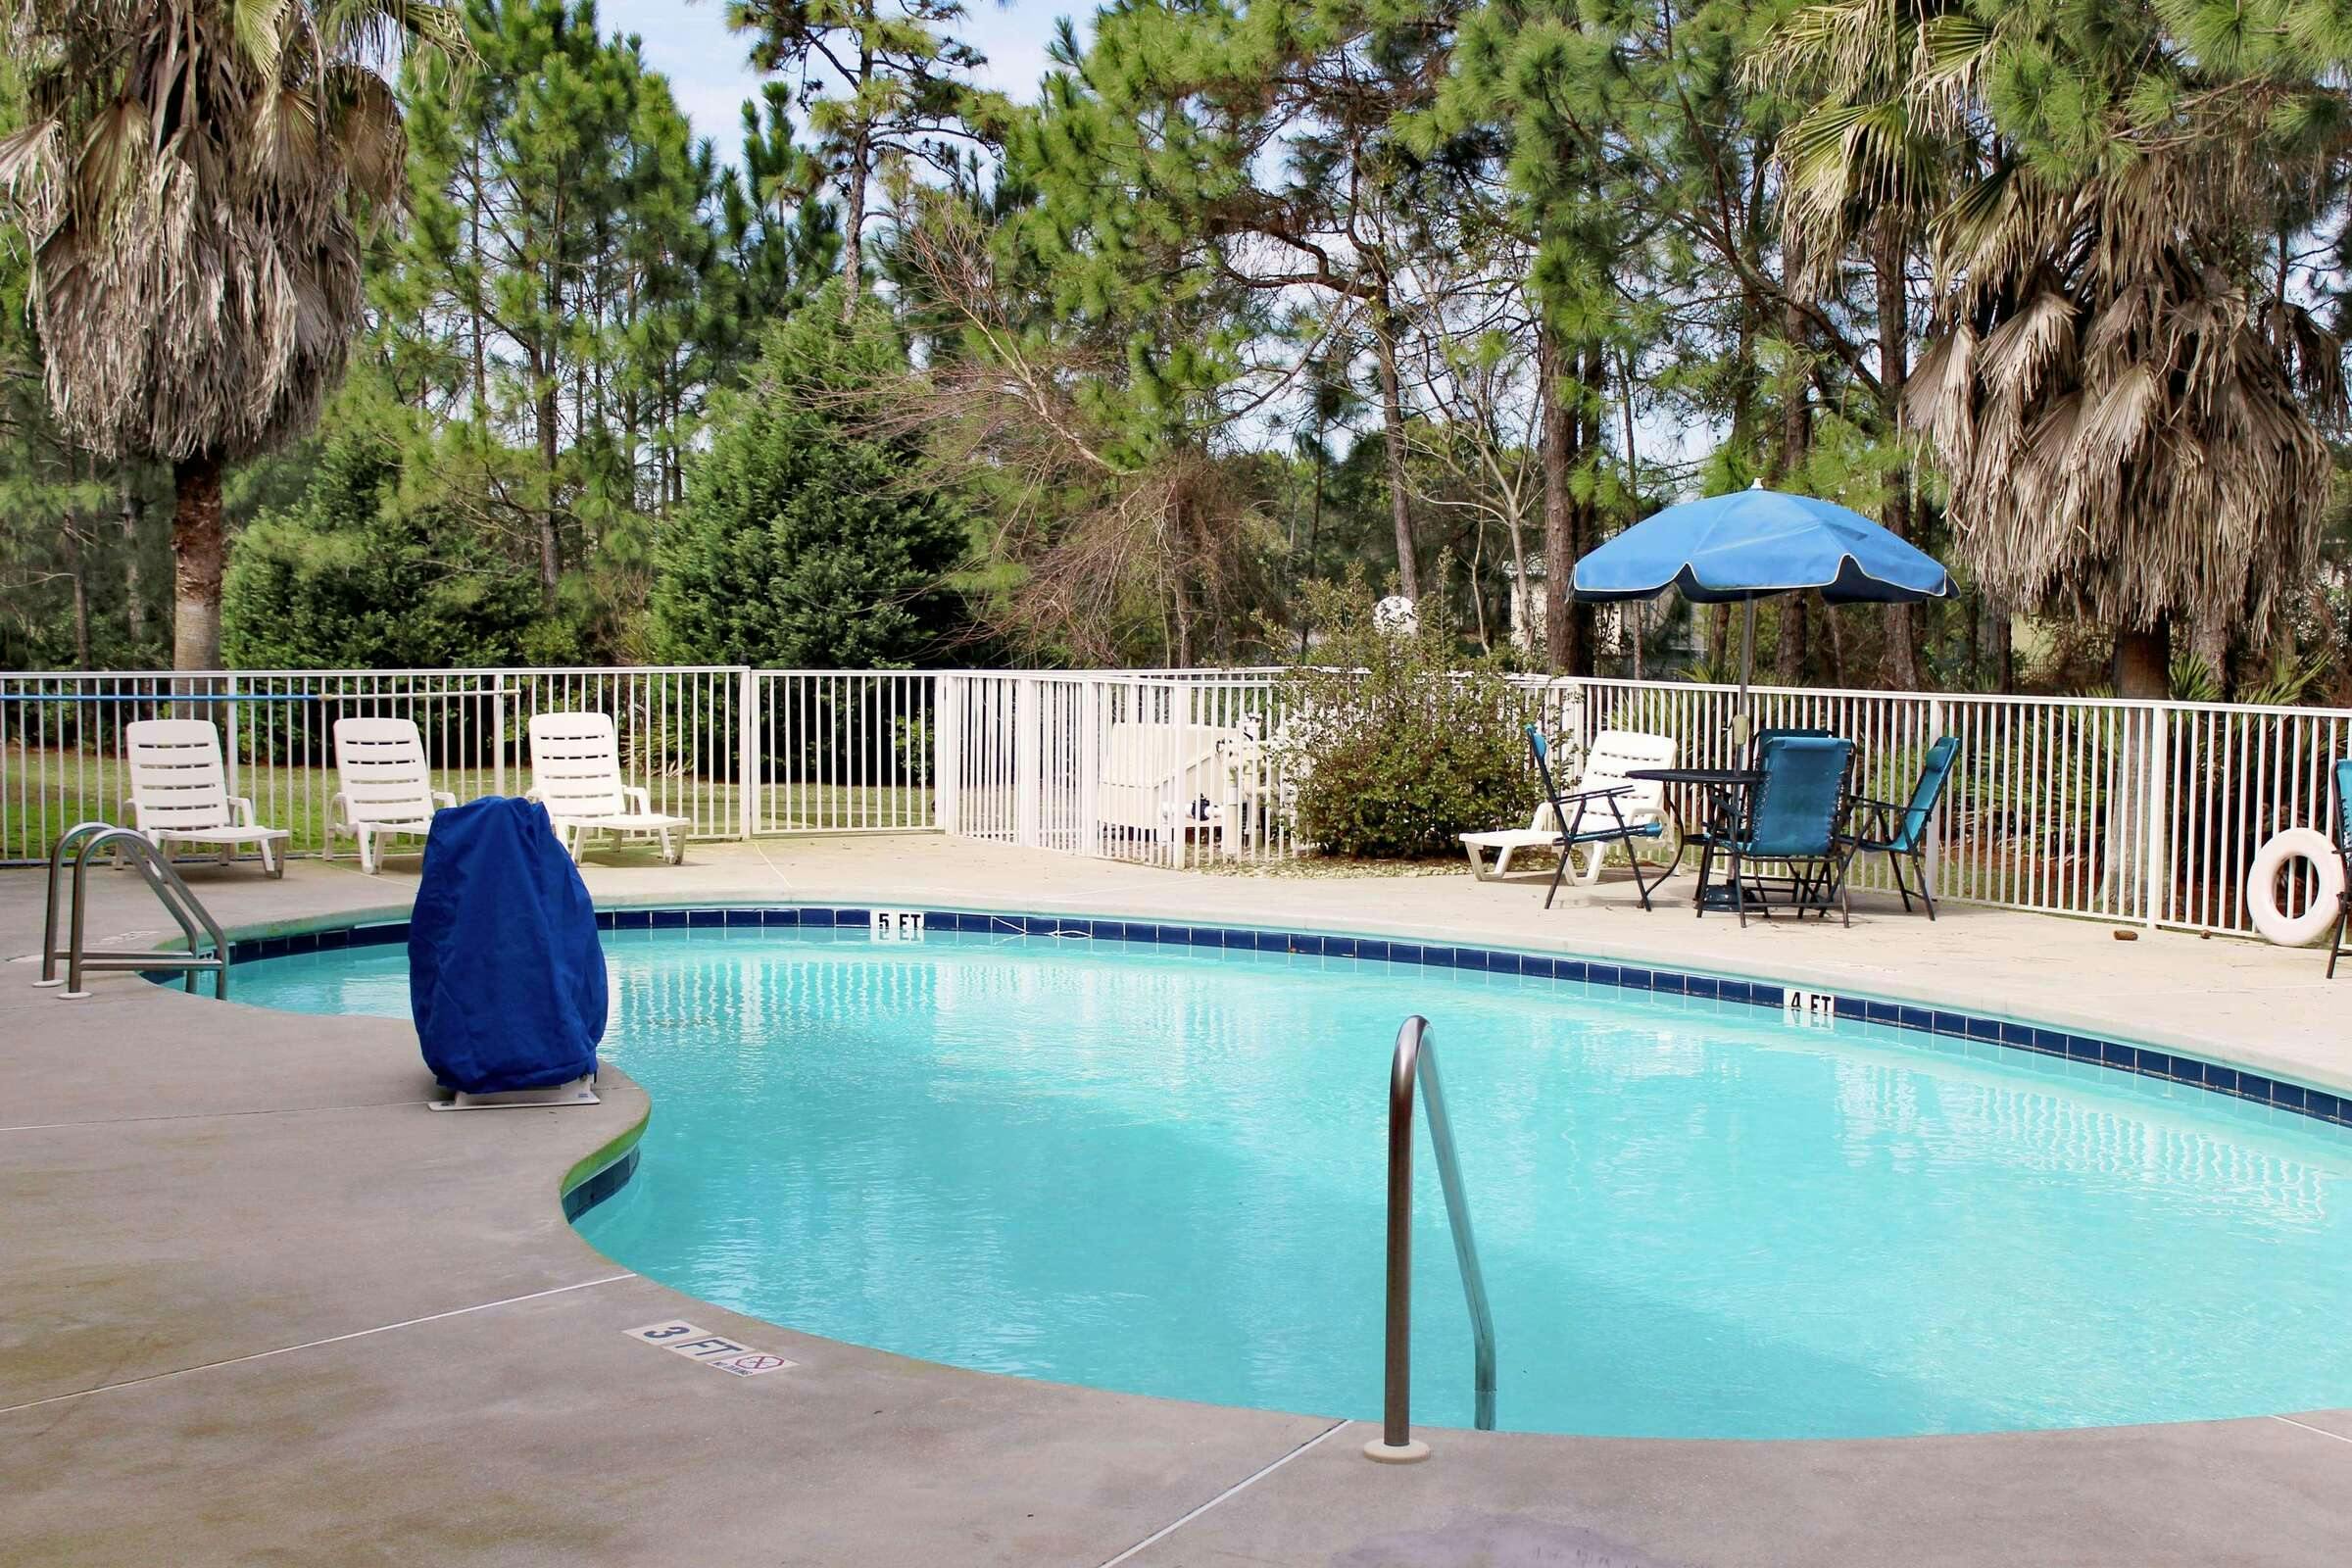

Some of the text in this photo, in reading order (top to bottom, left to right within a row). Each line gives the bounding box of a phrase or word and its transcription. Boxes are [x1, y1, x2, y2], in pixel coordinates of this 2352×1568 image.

[878, 913, 921, 929] 5 FT
[1791, 992, 1832, 1012] 4 FT
[643, 1326, 744, 1356] 3 FT
